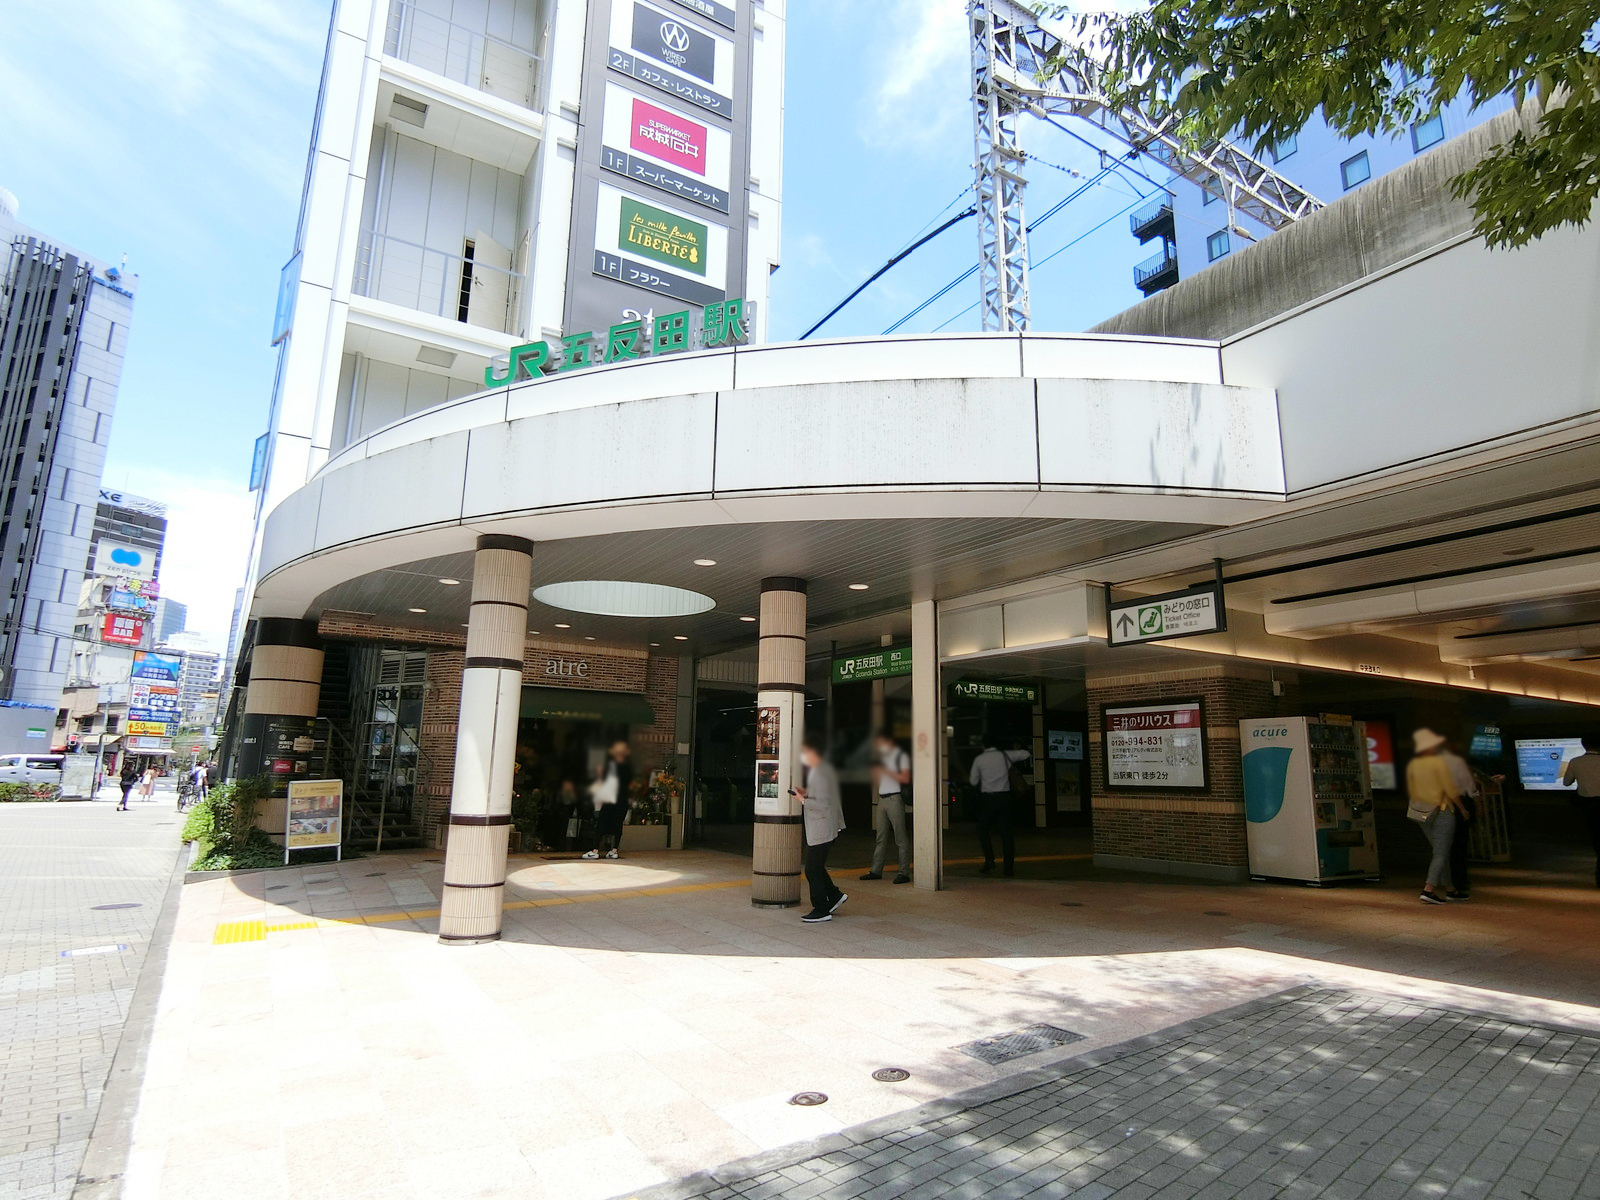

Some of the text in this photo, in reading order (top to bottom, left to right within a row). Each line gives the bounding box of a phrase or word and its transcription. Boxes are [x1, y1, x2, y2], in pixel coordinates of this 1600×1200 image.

[613, 53, 630, 70] 2F
[662, 47, 687, 64] WIRED
[665, 56, 682, 67] CAFE
[641, 68, 720, 107] カフェ・レストラン
[649, 119, 690, 142] SUPERMARKET
[639, 124, 699, 158] 成城石井
[608, 152, 624, 169] 1F
[635, 165, 720, 204] スーパーマーケット
[600, 256, 617, 273] 1F
[629, 269, 671, 287] フラワー
[1164, 597, 1210, 614] みどりの窓口
[1165, 612, 1200, 623] Ticket Office
[545, 657, 588, 677] atré
[840, 660, 855, 675] JR
[856, 655, 884, 670] 五反田駅
[856, 668, 888, 678] Gotanda Station
[964, 683, 978, 694] JR
[1113, 714, 1172, 729] 三井のリハウス
[1111, 736, 1163, 747] 0120-994-831
[1252, 728, 1288, 738] acure
